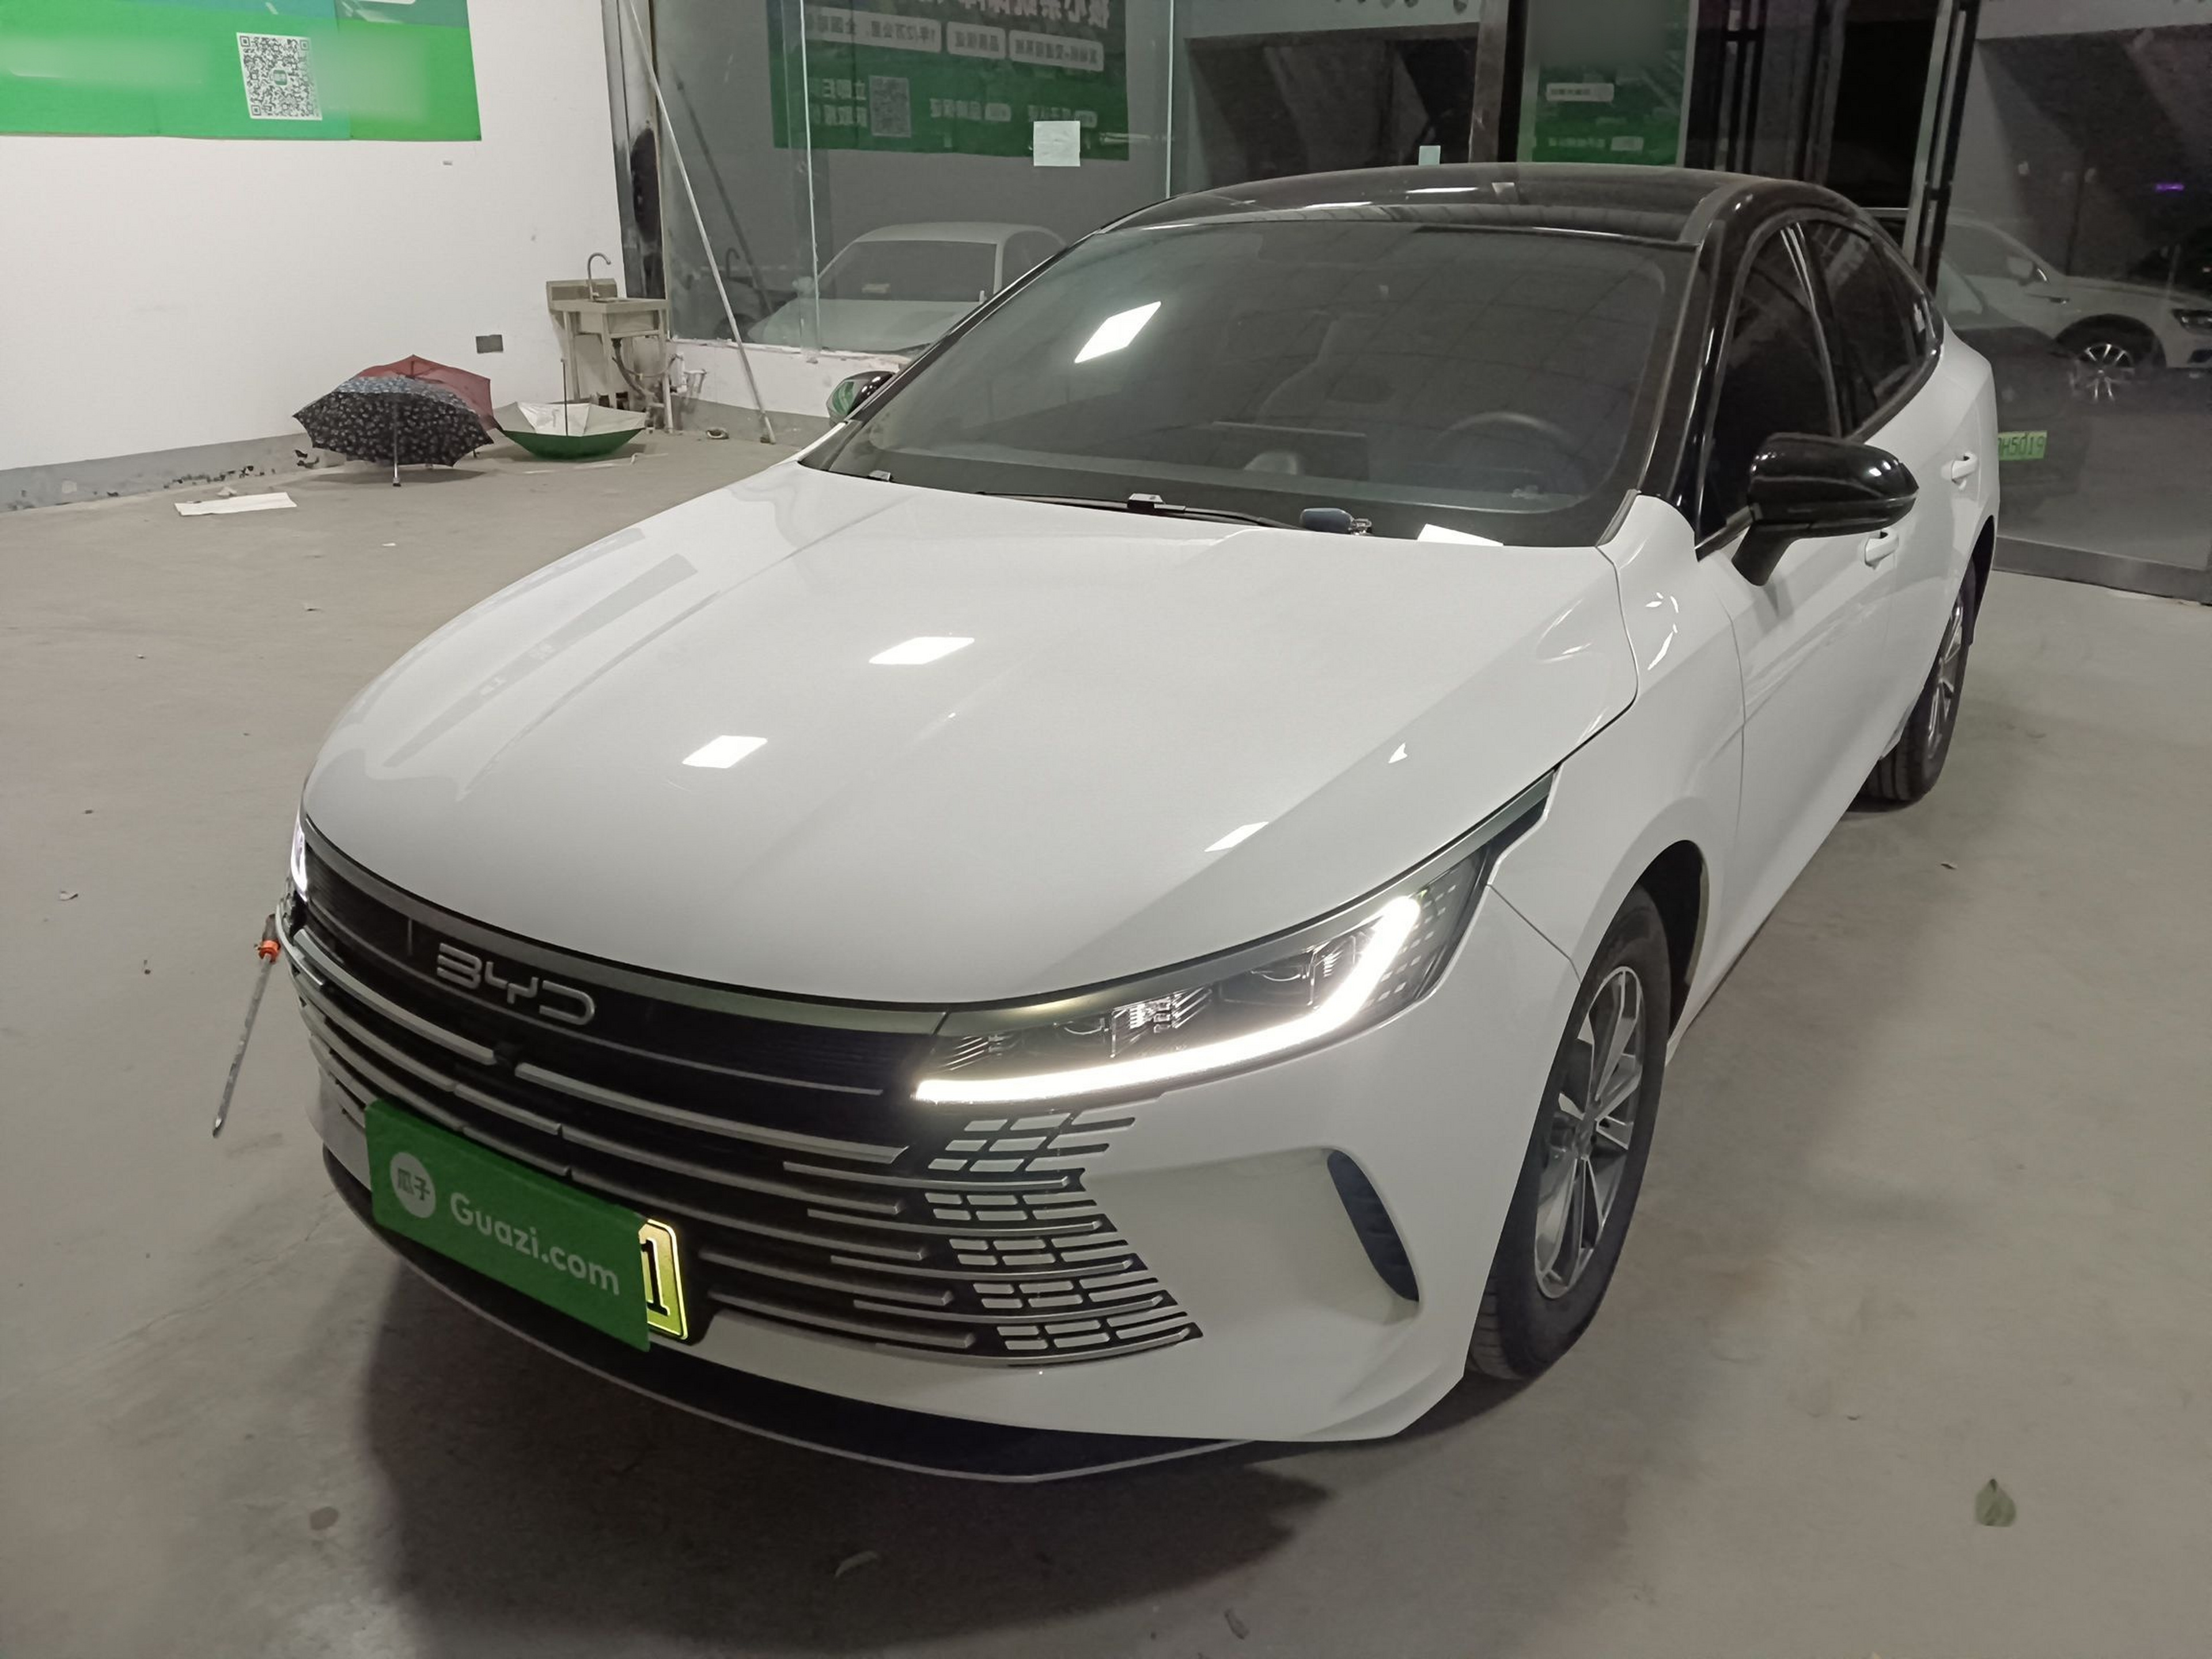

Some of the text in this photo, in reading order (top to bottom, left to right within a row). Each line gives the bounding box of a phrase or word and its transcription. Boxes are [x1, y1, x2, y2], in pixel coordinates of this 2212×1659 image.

[437, 942, 596, 1025] BYD
[396, 1168, 431, 1202] 瓜子
[450, 1192, 620, 1296] Guazi.com
